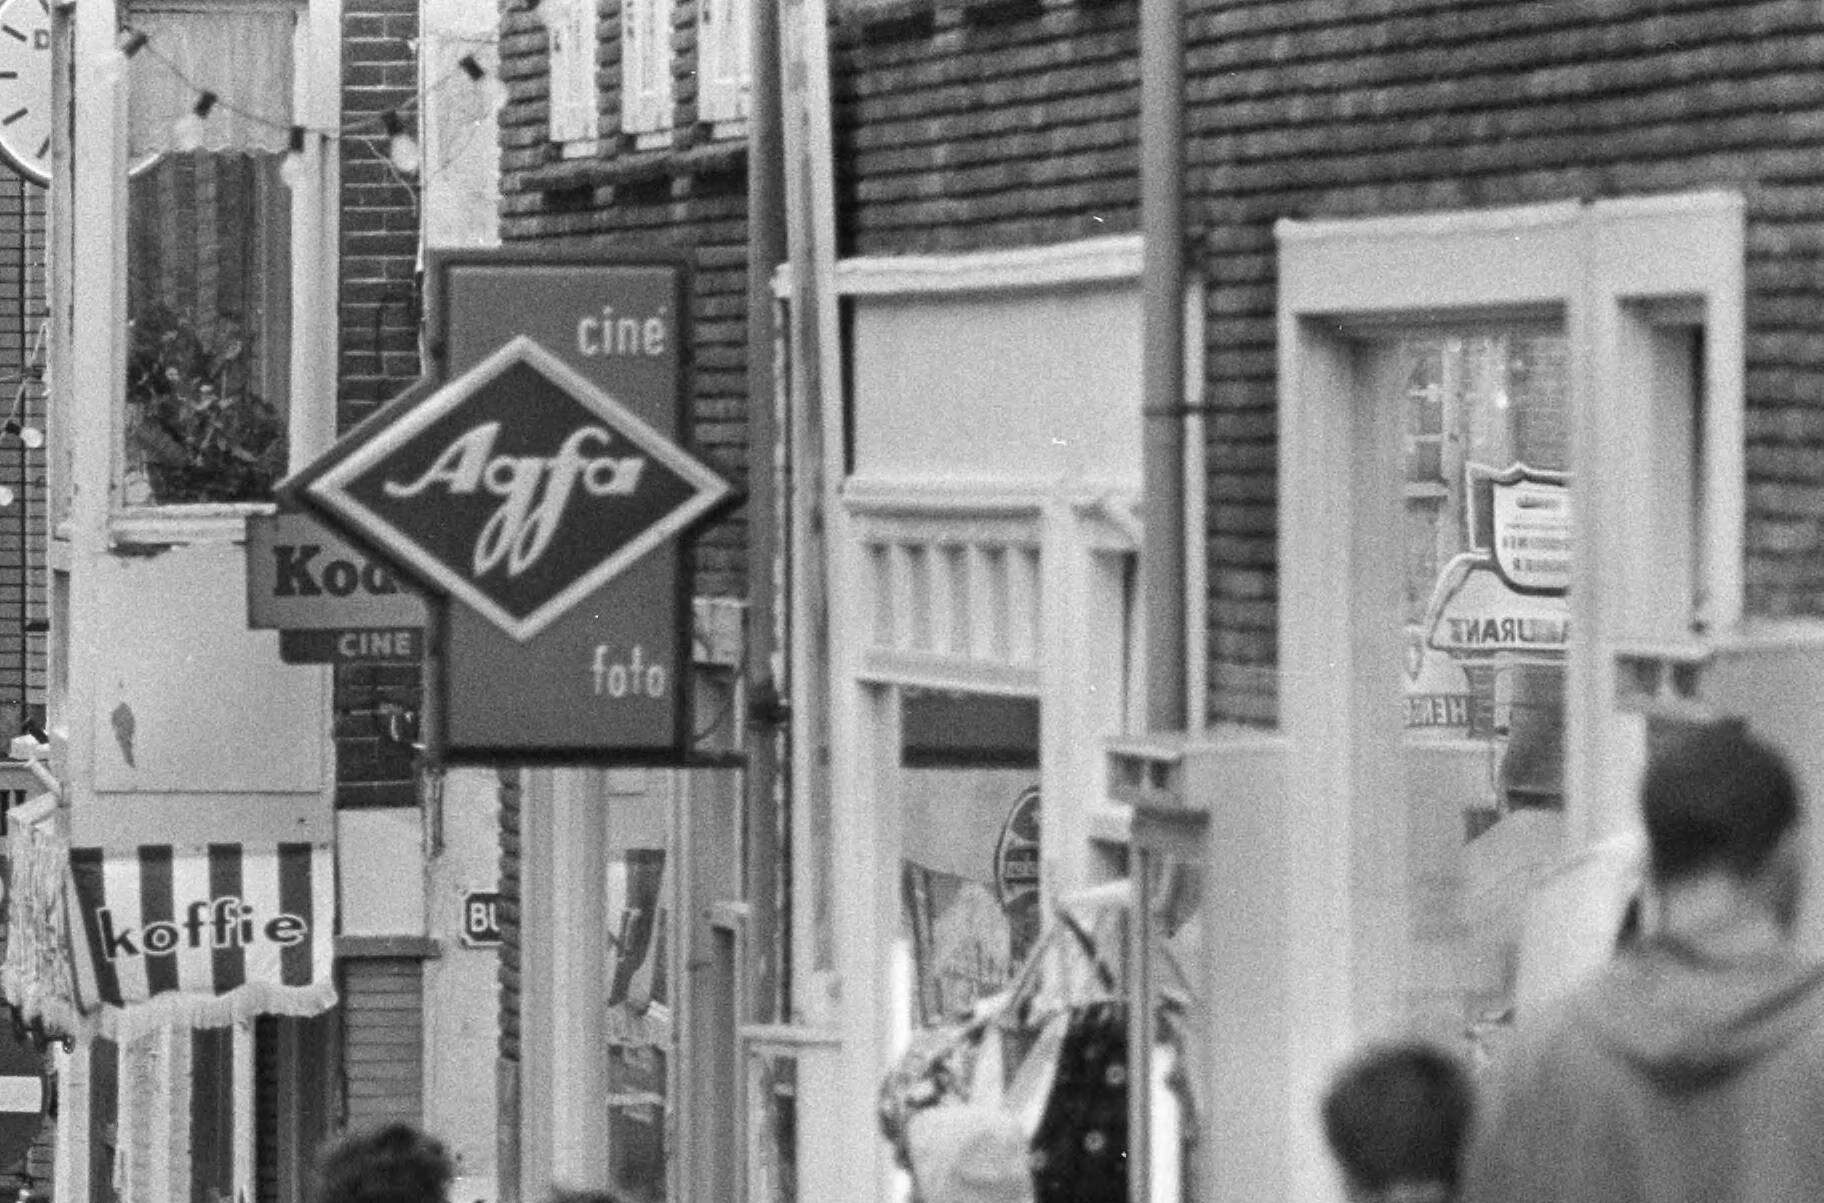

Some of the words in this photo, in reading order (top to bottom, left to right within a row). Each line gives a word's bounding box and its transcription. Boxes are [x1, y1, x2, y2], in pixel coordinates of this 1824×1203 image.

[384, 421, 646, 578] Agfa
[338, 632, 411, 656] CINE
[591, 645, 666, 698] foto
[96, 896, 309, 962] koffie
